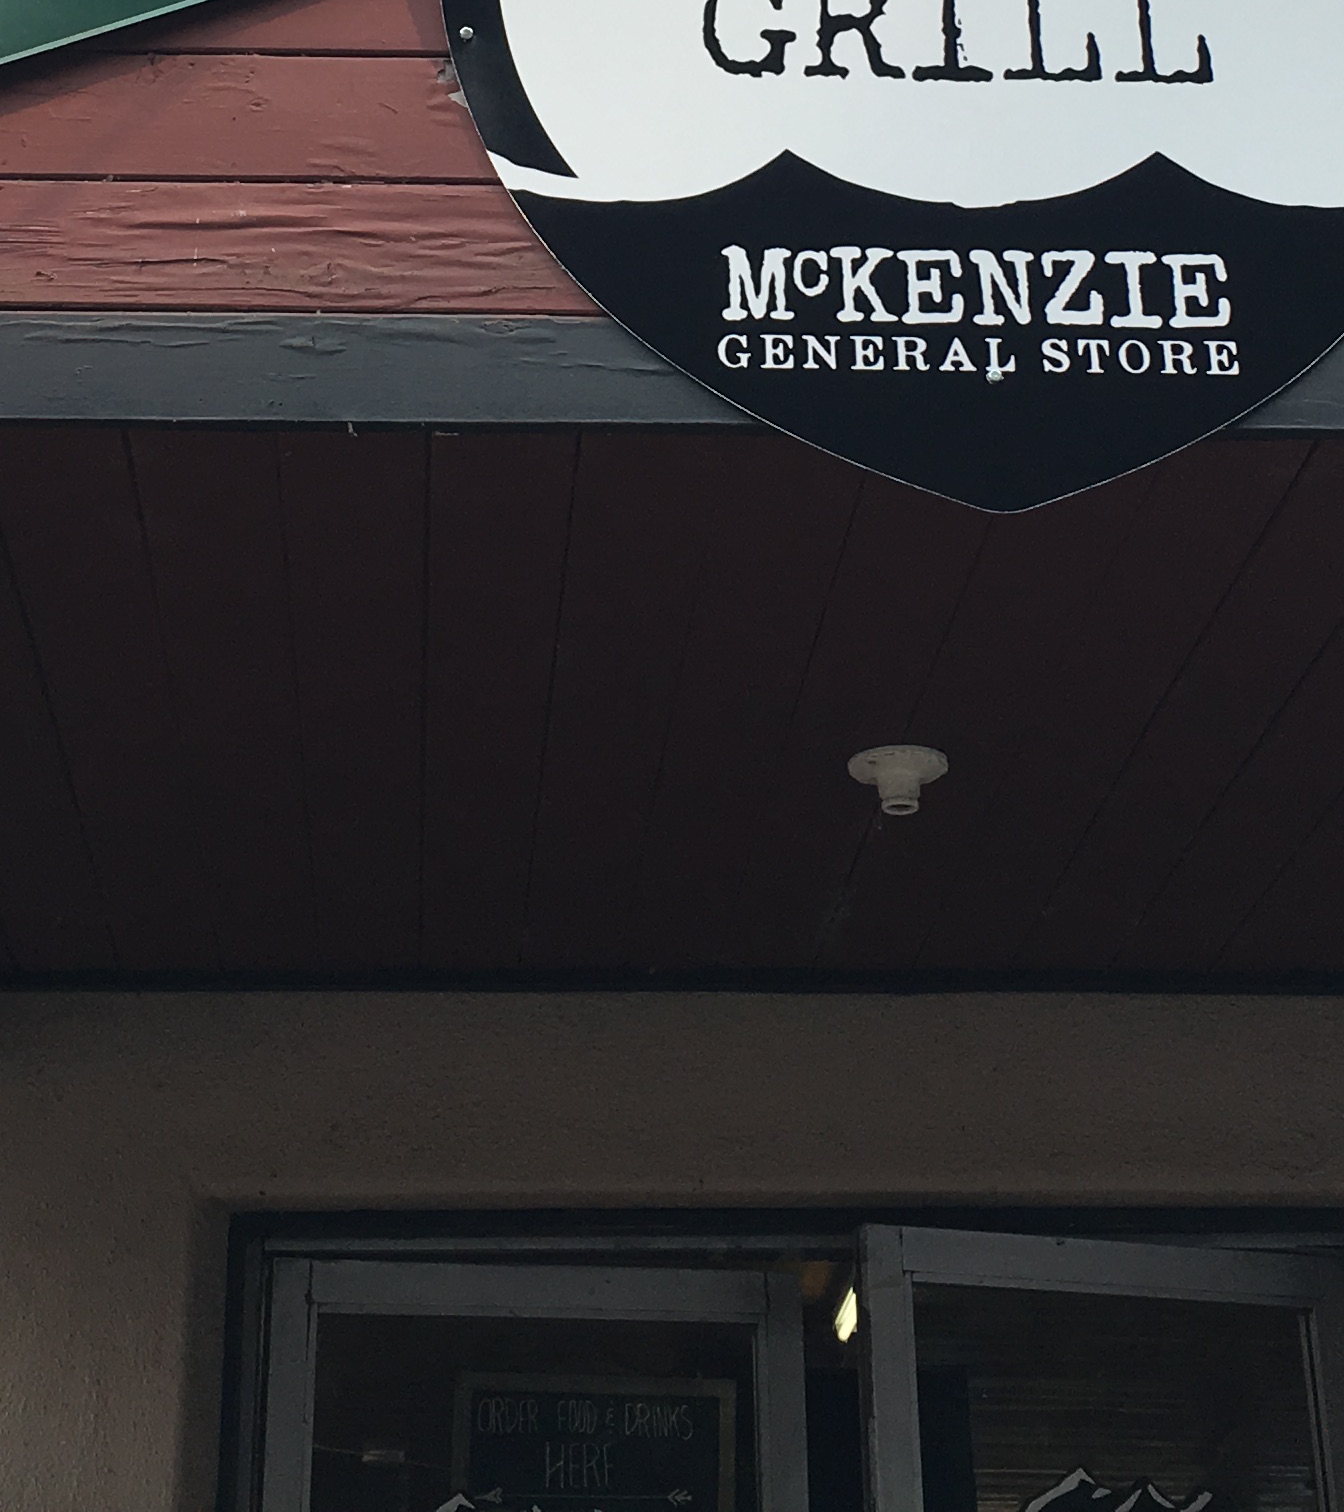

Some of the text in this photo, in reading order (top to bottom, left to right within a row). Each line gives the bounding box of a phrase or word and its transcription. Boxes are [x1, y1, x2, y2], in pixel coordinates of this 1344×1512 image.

[717, 334, 1240, 375] GENERAL STORE
[476, 1396, 540, 1435] ORDER
[556, 1398, 598, 1435] FOOD
[622, 1401, 695, 1442] DRINKS
[544, 1440, 615, 1490] HERE
